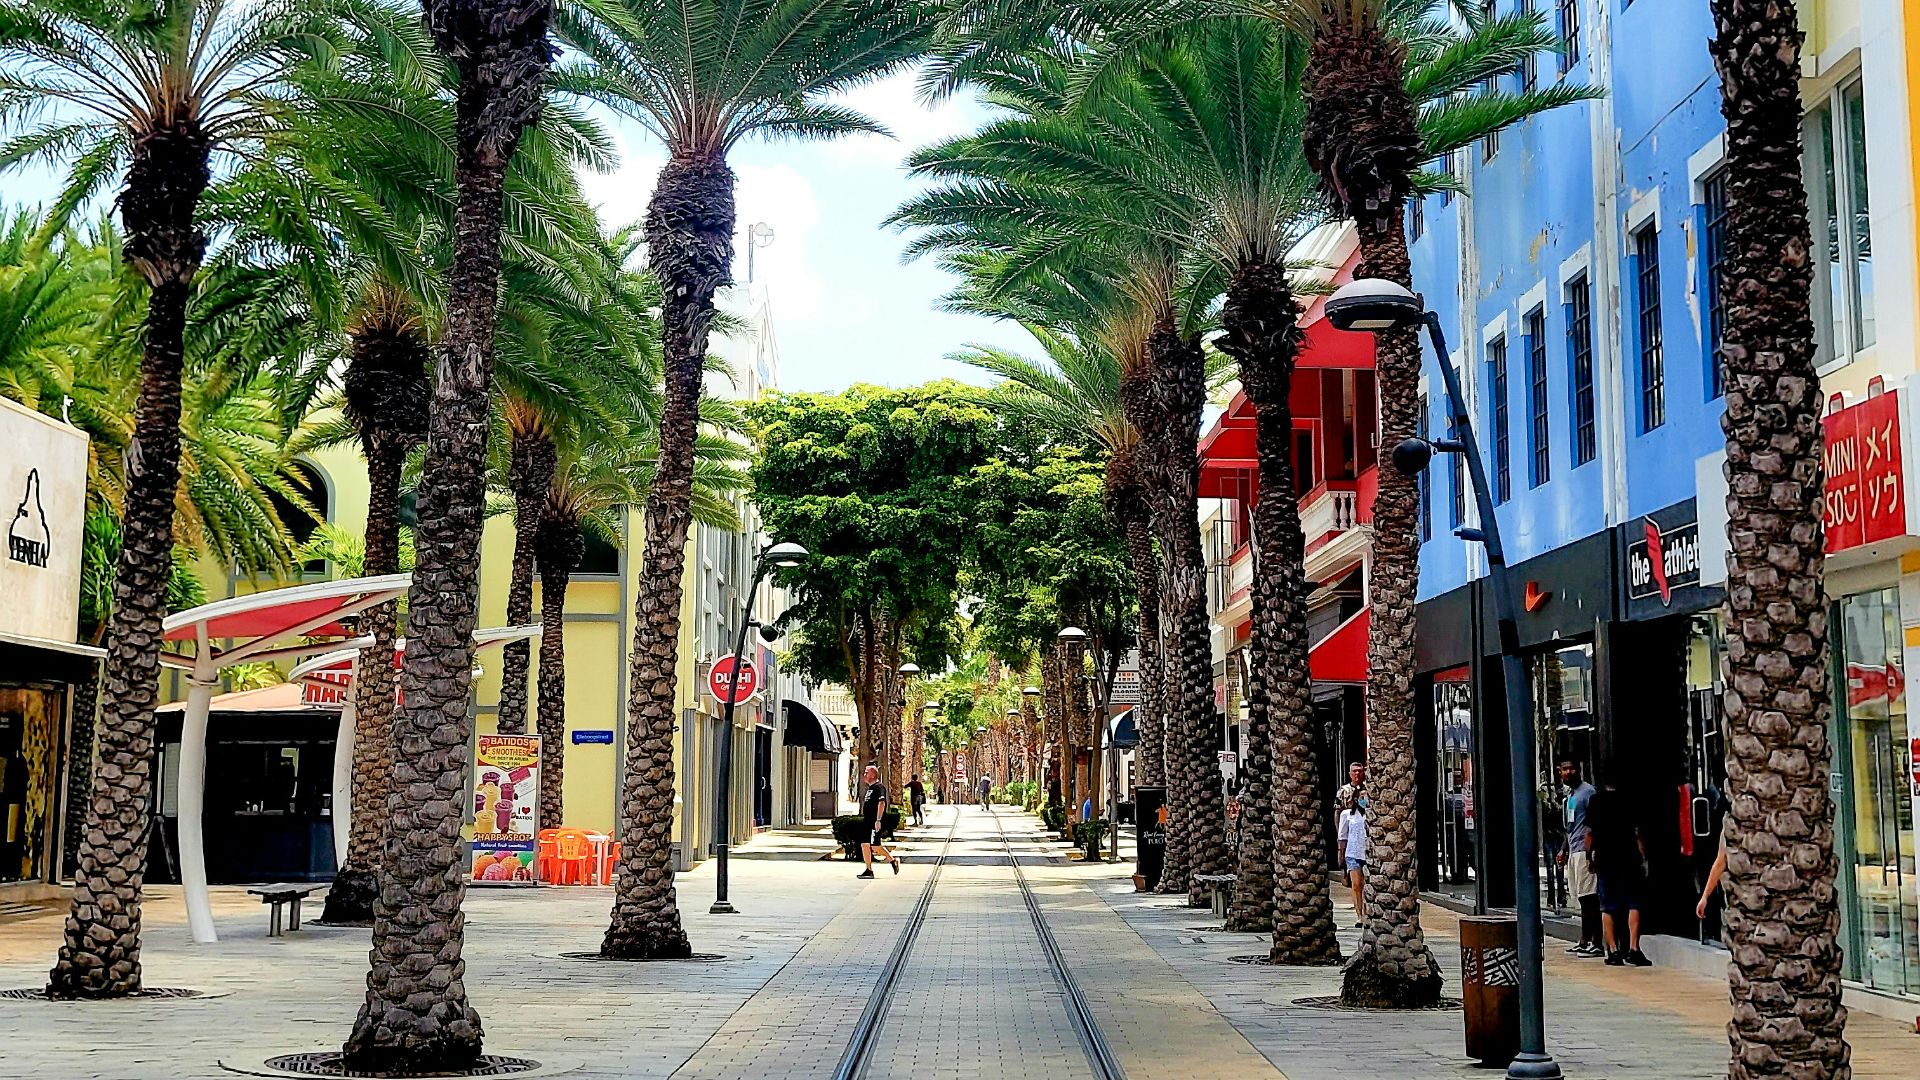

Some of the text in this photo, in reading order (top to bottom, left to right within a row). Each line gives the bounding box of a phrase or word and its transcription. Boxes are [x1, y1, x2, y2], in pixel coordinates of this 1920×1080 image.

[1825, 436, 1856, 479] MINI
[1631, 534, 1700, 587] the athlet
[715, 672, 752, 684] DUHI
[491, 737, 529, 746] BATIDOS
[491, 747, 528, 757] SMOOTHIES
